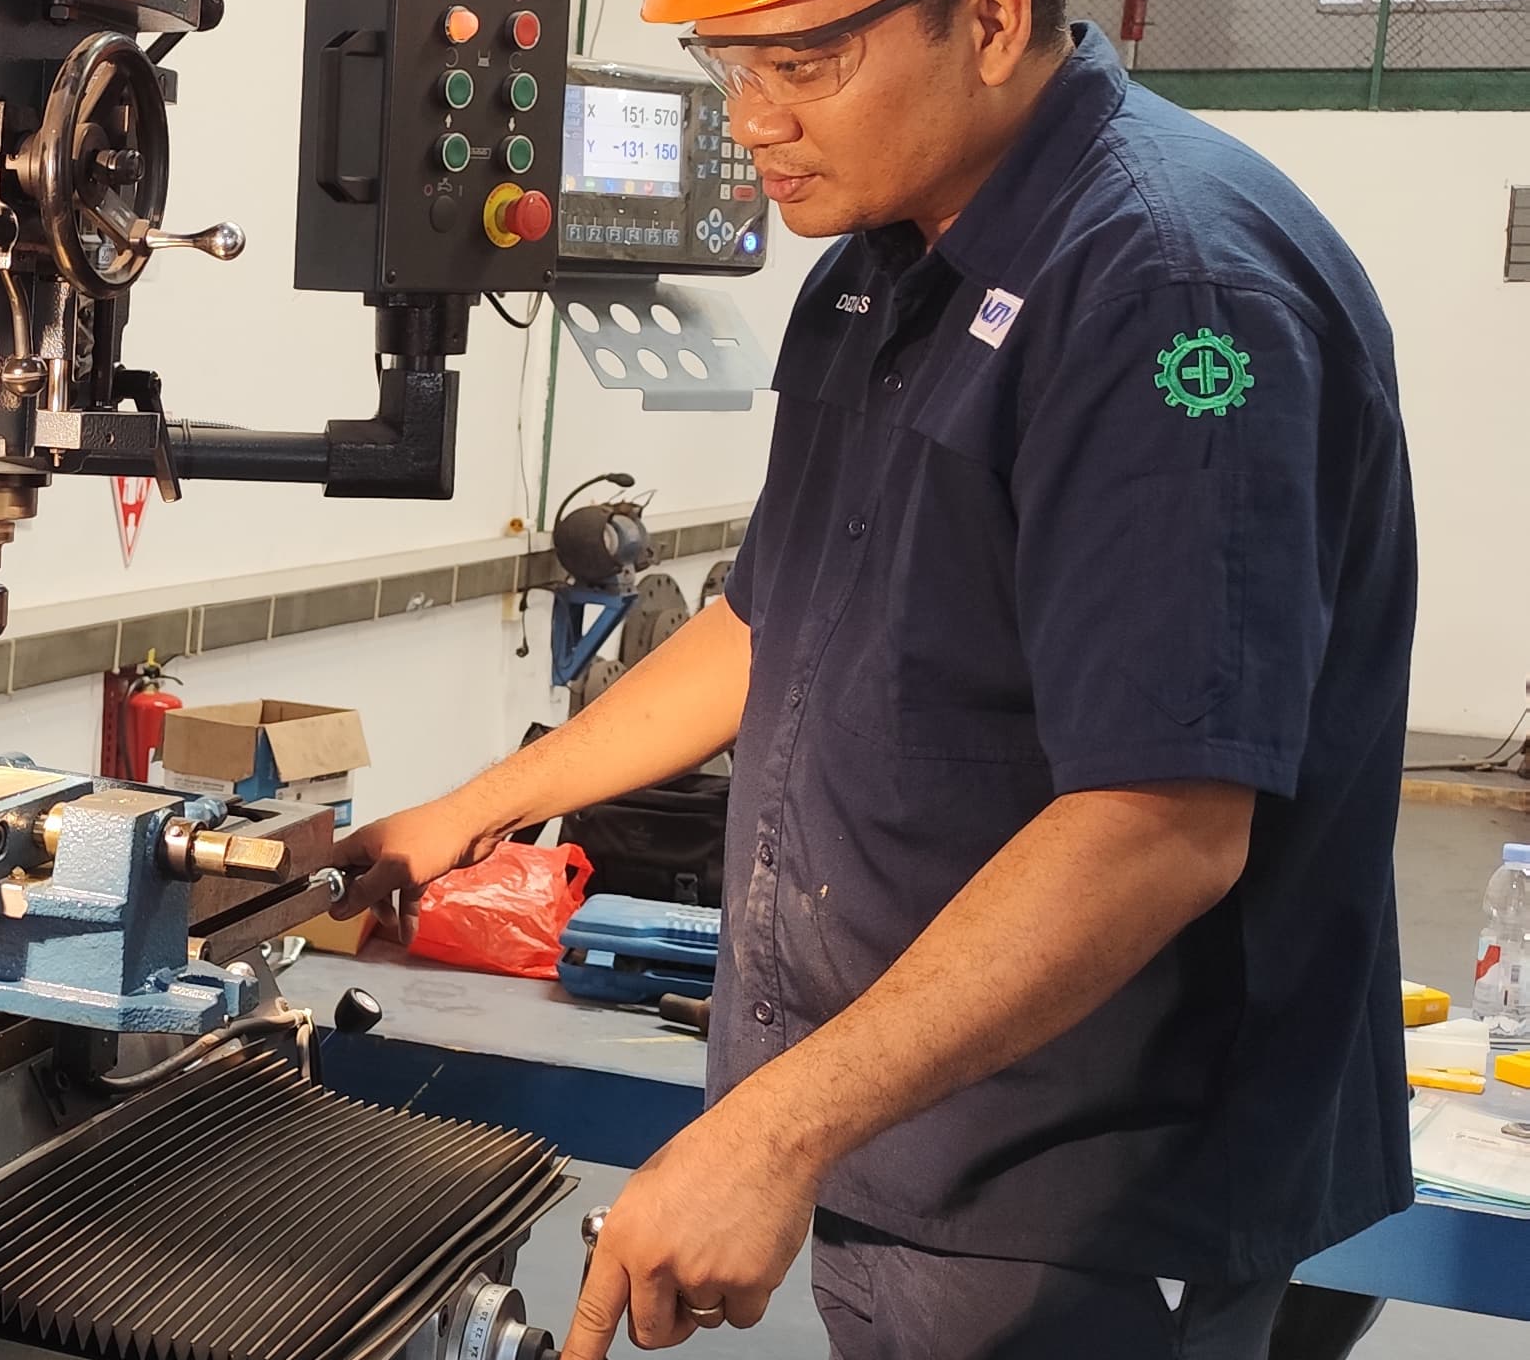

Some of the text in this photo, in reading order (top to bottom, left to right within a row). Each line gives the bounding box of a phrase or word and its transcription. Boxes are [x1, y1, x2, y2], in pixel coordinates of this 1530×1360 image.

[587, 104, 596, 118] X
[587, 140, 595, 152] Y
[697, 165, 706, 179] Z
[570, 226, 678, 243] F1 F2 F3 F4 F5 F6
